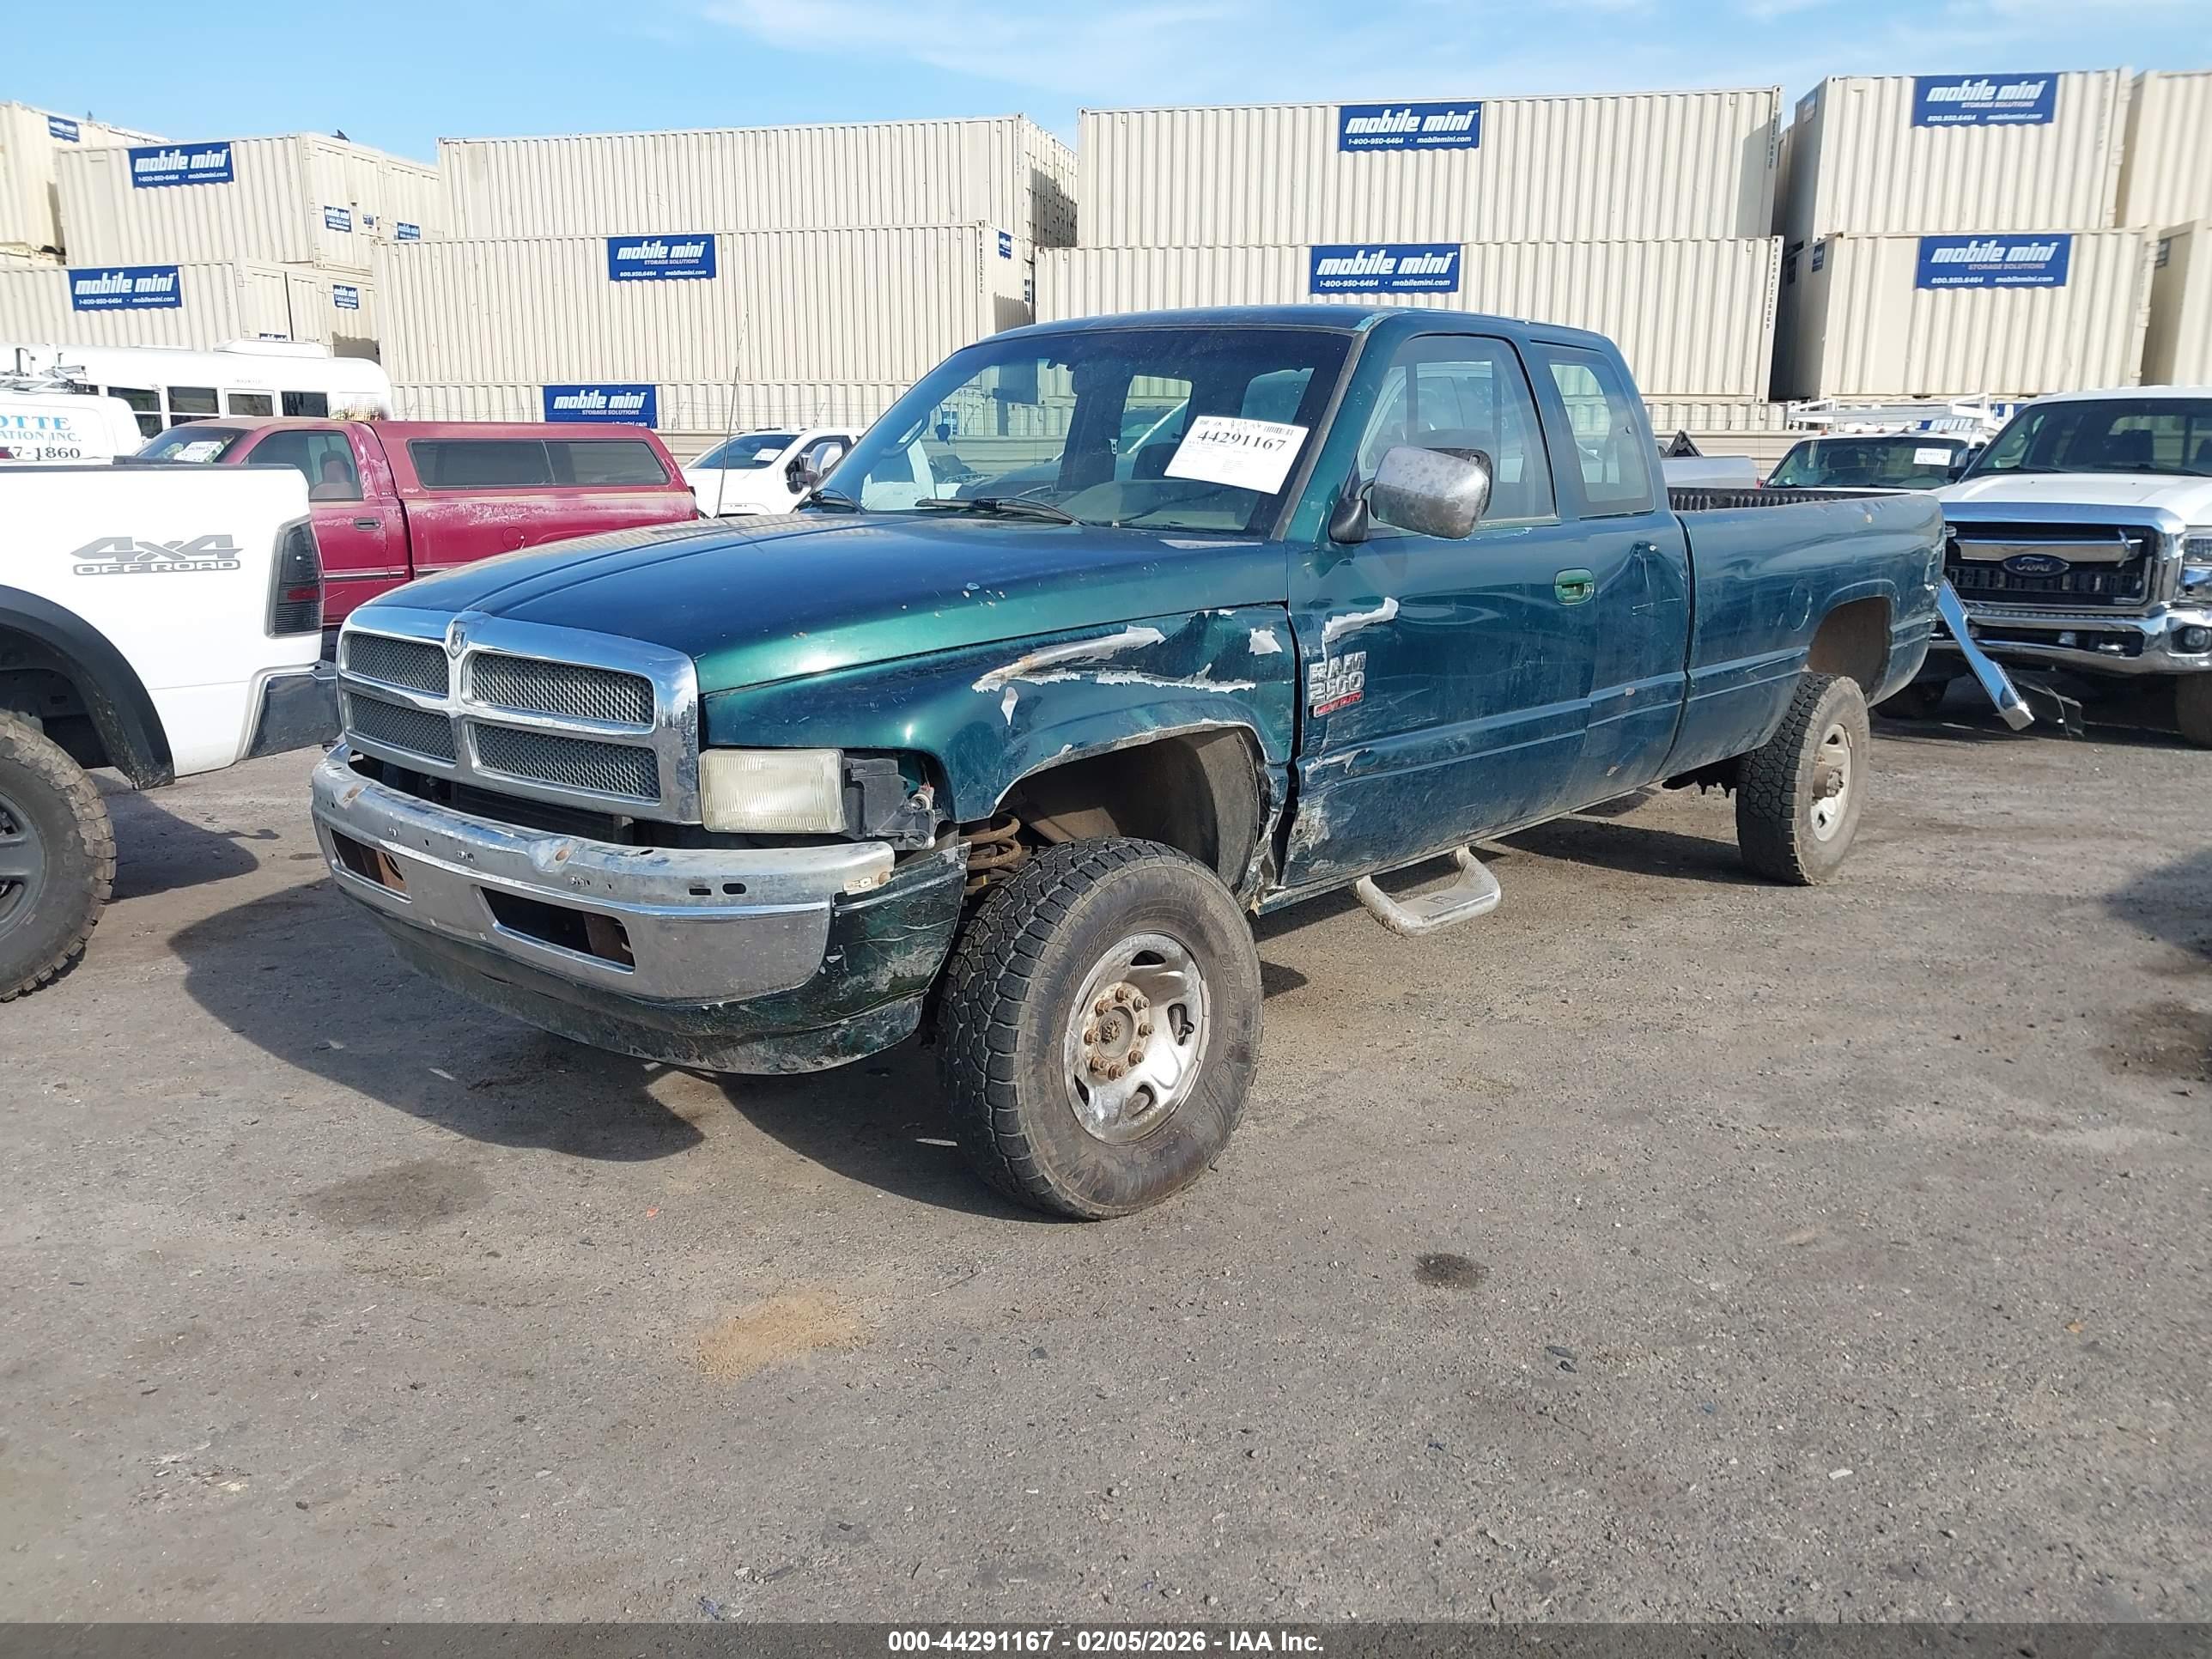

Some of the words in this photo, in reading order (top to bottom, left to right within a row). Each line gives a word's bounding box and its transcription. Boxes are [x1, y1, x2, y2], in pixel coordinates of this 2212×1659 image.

[1926, 79, 1997, 102] mobile
[1995, 80, 2047, 100] mini
[1345, 108, 1421, 134] mobile
[1421, 110, 1476, 132] mini
[1416, 136, 1472, 144] mobilemini.com
[135, 149, 189, 172] mobile
[190, 149, 228, 169] mini
[617, 240, 669, 260] mobile
[670, 241, 705, 258] mini
[1931, 240, 2006, 263] mobile
[2005, 242, 2057, 262] mini
[1316, 249, 1397, 276] mobile
[1397, 252, 1454, 275] mini
[75, 271, 132, 295] mobile
[134, 272, 174, 293] mini
[1319, 279, 1379, 288] 1-800-950-6464
[553, 390, 607, 409] mobile
[609, 392, 647, 409] mini
[51, 432, 82, 442] INC.
[1197, 430, 1287, 452] 44291167
[76, 563, 143, 574] OFF
[150, 560, 239, 573] ROAD
[2016, 556, 2053, 572] Ford
[1308, 671, 1365, 705] 2500
